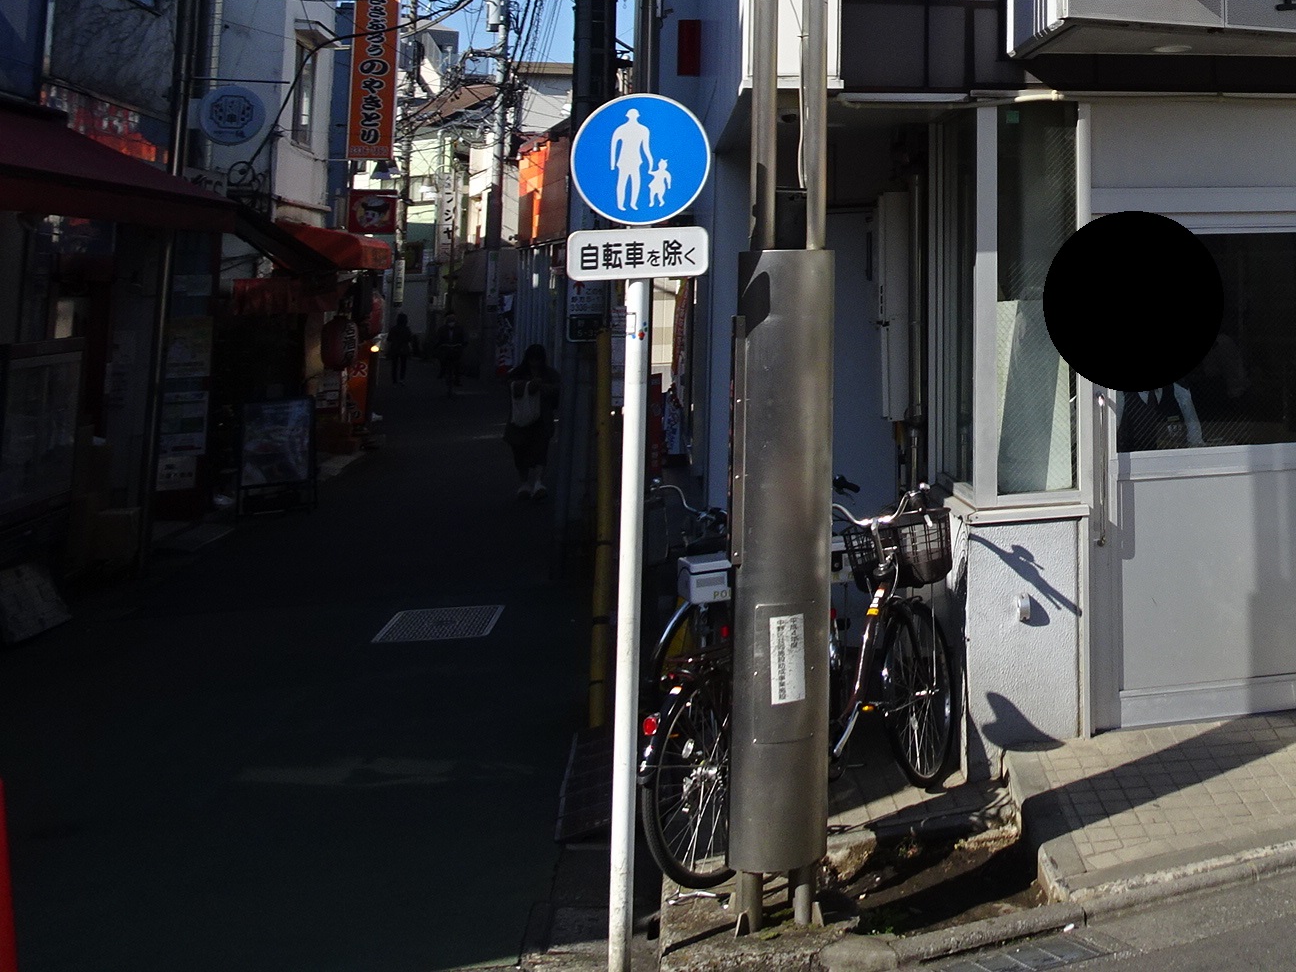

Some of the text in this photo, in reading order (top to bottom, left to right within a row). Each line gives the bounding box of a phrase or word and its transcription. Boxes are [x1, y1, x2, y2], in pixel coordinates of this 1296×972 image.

[580, 240, 696, 270] 自転車を除く
